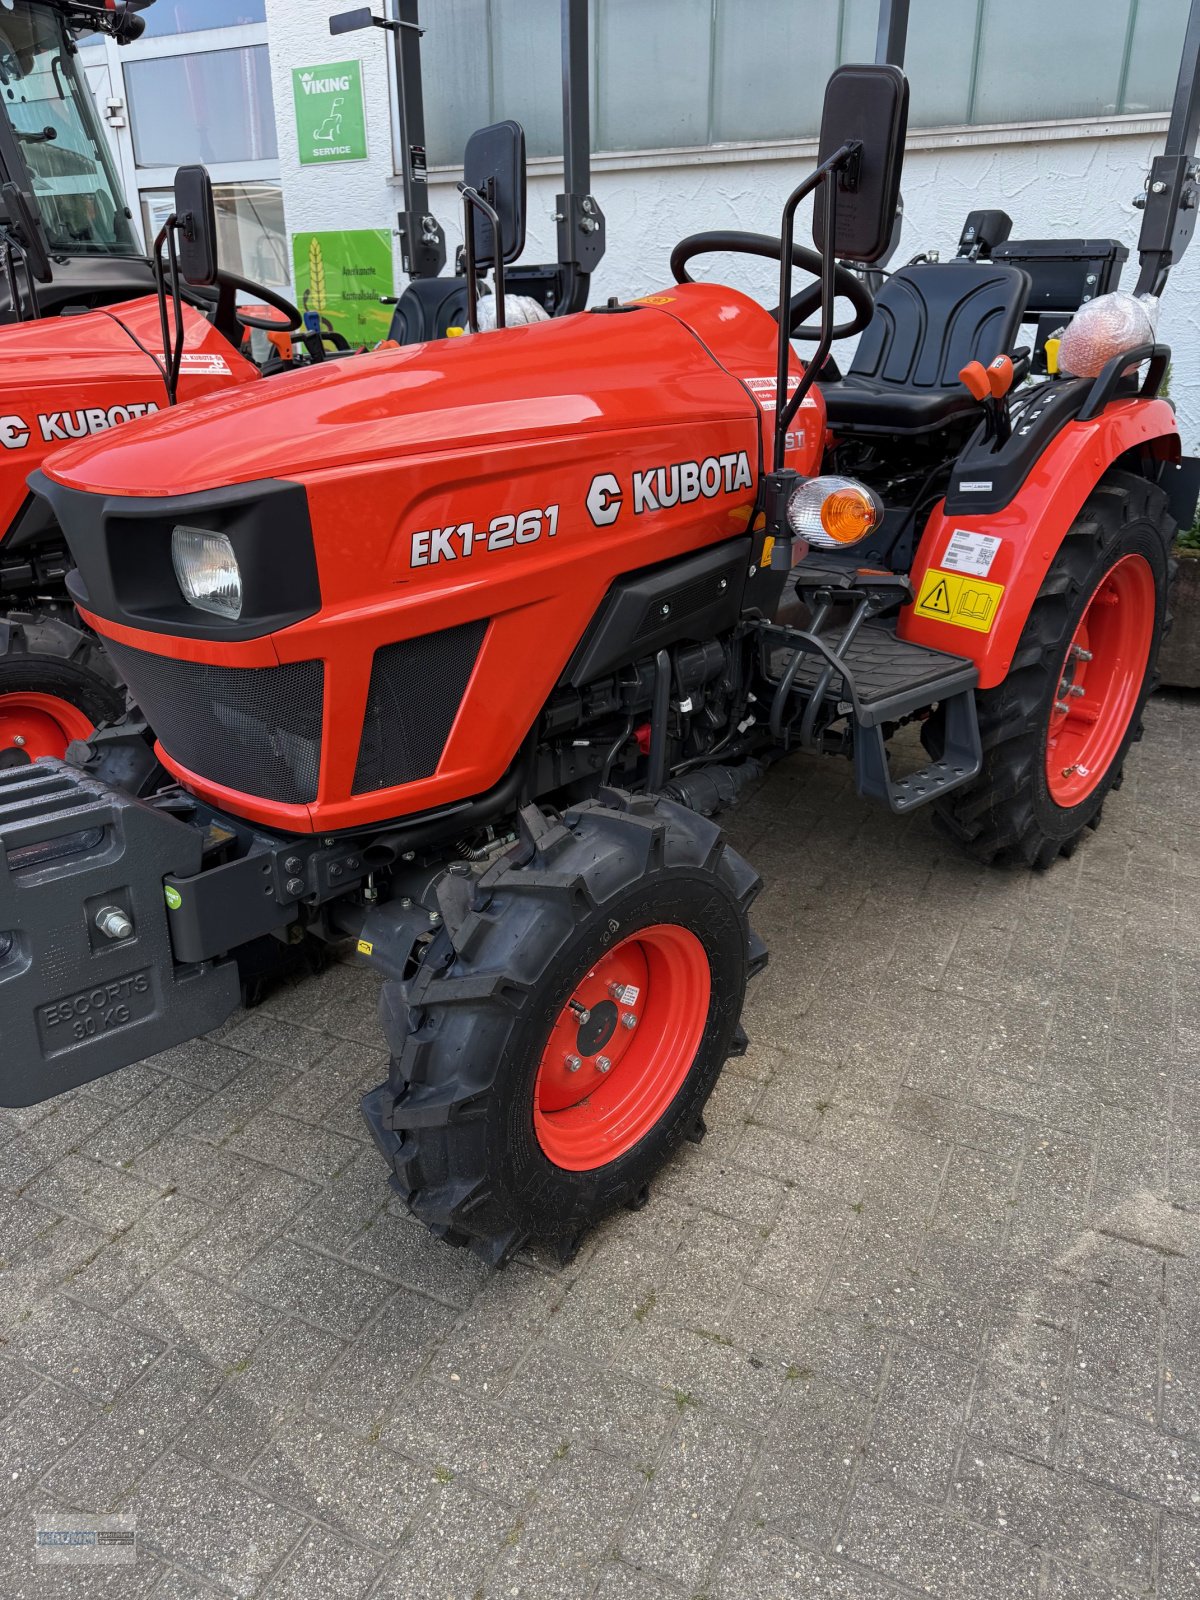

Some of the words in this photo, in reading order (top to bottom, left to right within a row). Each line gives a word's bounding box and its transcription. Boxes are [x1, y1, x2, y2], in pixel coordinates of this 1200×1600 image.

[302, 76, 350, 95] VIKING
[313, 145, 351, 156] SERVICE
[632, 450, 753, 515] KUBOTA
[410, 504, 560, 568] EK1-261
[42, 974, 149, 1027] ESCORTS
[101, 1004, 130, 1030] KG
